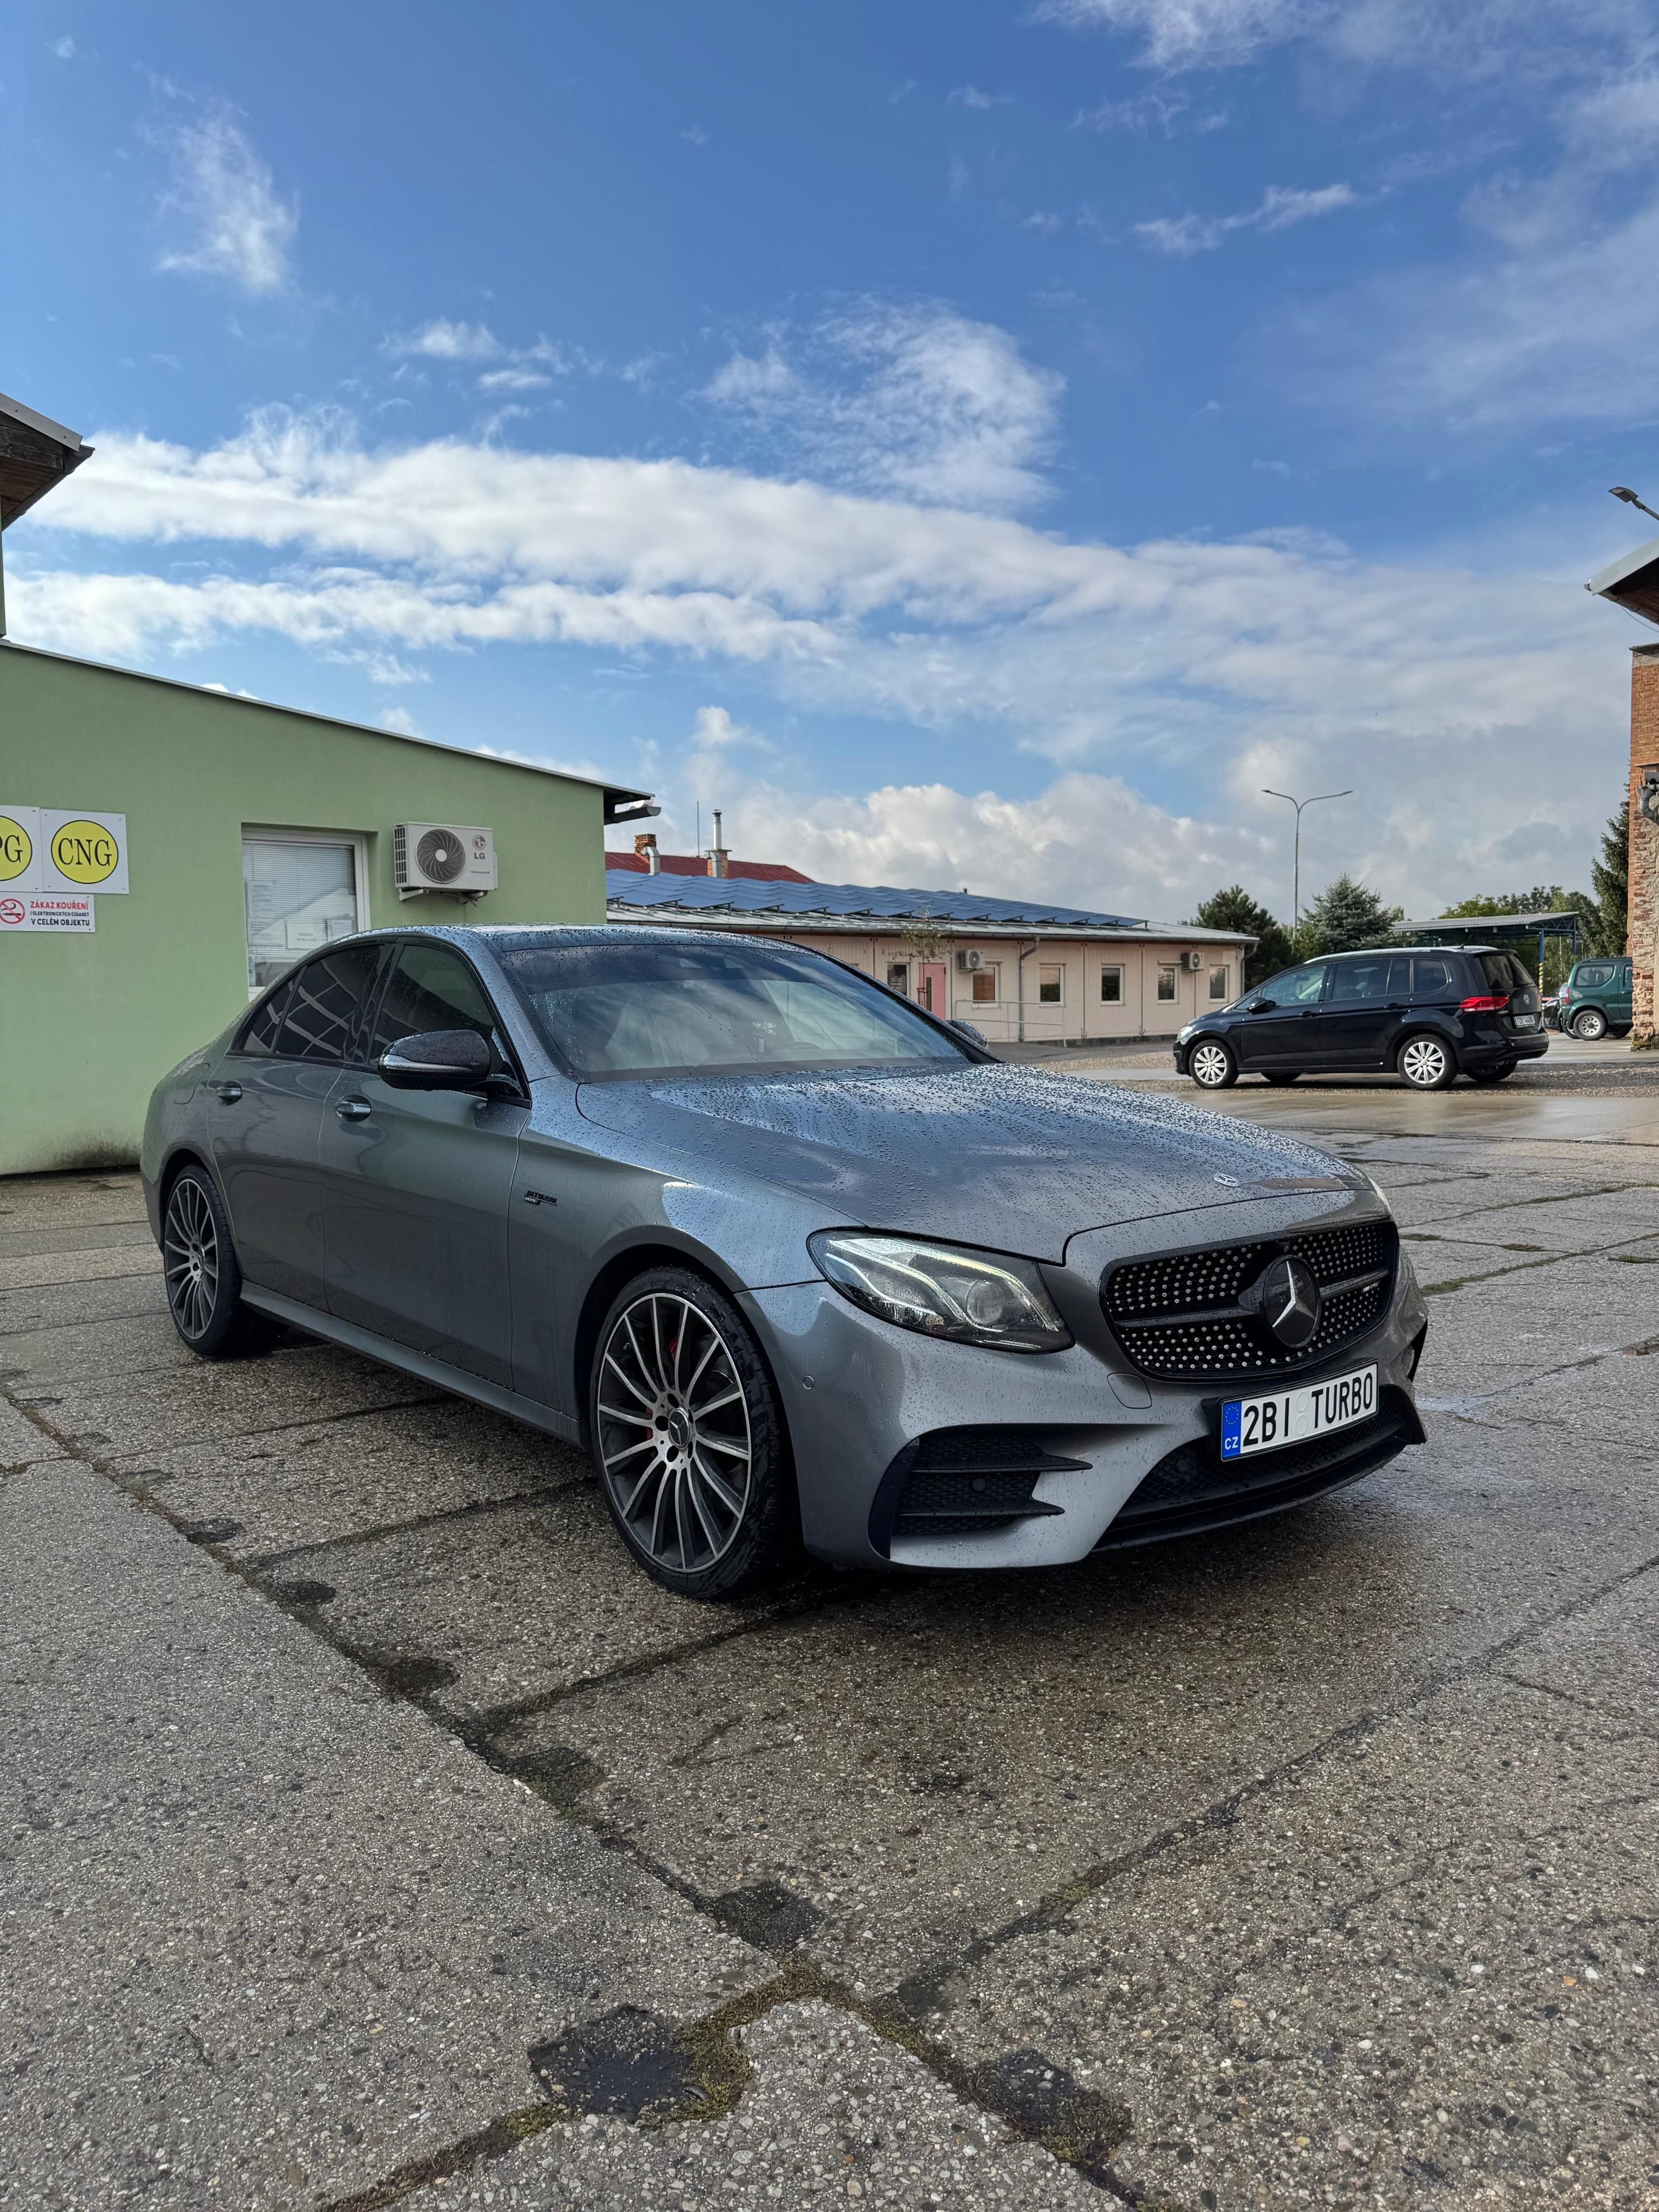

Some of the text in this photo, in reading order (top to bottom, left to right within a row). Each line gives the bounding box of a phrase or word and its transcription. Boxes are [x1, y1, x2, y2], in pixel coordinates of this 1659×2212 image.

[0, 835, 23, 863] G
[58, 838, 112, 866] CNG
[30, 899, 89, 909] ZÁKAZ KOUŘENÍ
[37, 917, 59, 925] CELÉM
[1311, 1372, 1373, 1428] TURBO
[1225, 1436, 1238, 1450] CZ
